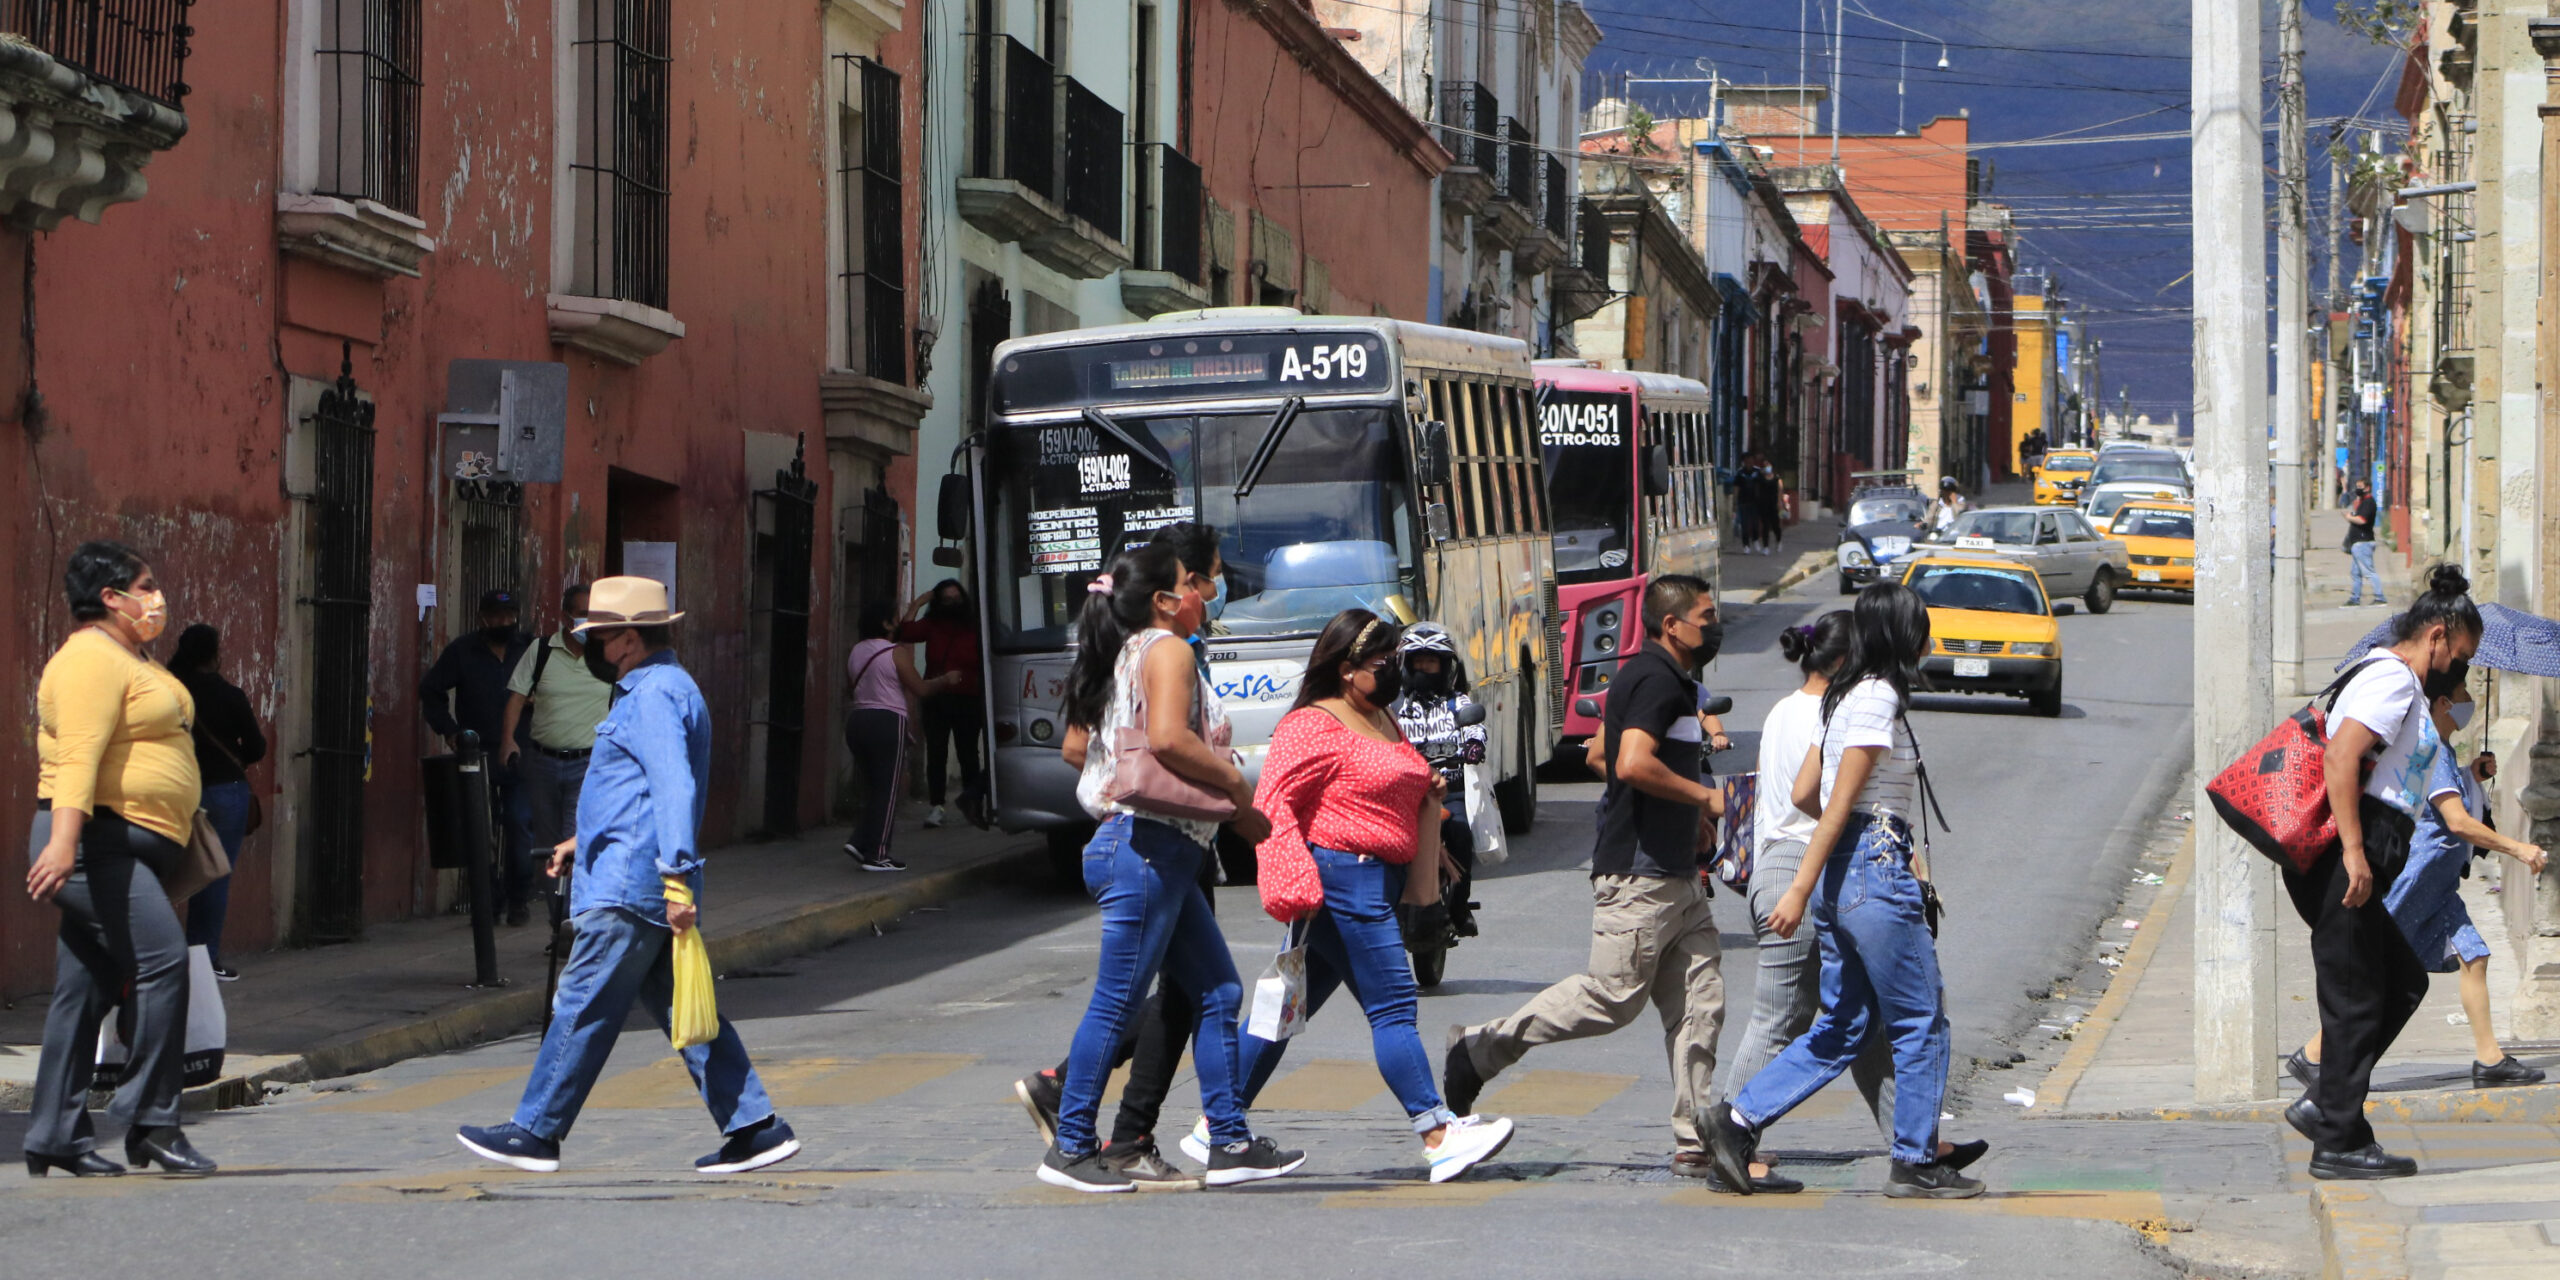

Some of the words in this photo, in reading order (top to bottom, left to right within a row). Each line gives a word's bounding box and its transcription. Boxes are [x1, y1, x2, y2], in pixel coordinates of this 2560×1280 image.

[1280, 344, 1368, 382] A-519
[1078, 453, 1130, 484] 159/V-002
[1080, 480, 1130, 493] A-CTRO-003
[1027, 507, 1098, 521] INDEPENDENCIA
[1136, 506, 1194, 519] PALACIOS
[2128, 508, 2192, 519] REFORMA
[1029, 518, 1099, 532] CENTRO
[1029, 530, 1071, 542] PORFIRIO
[1076, 528, 1099, 539] DIAZ
[1030, 542, 1071, 553] IMSS
